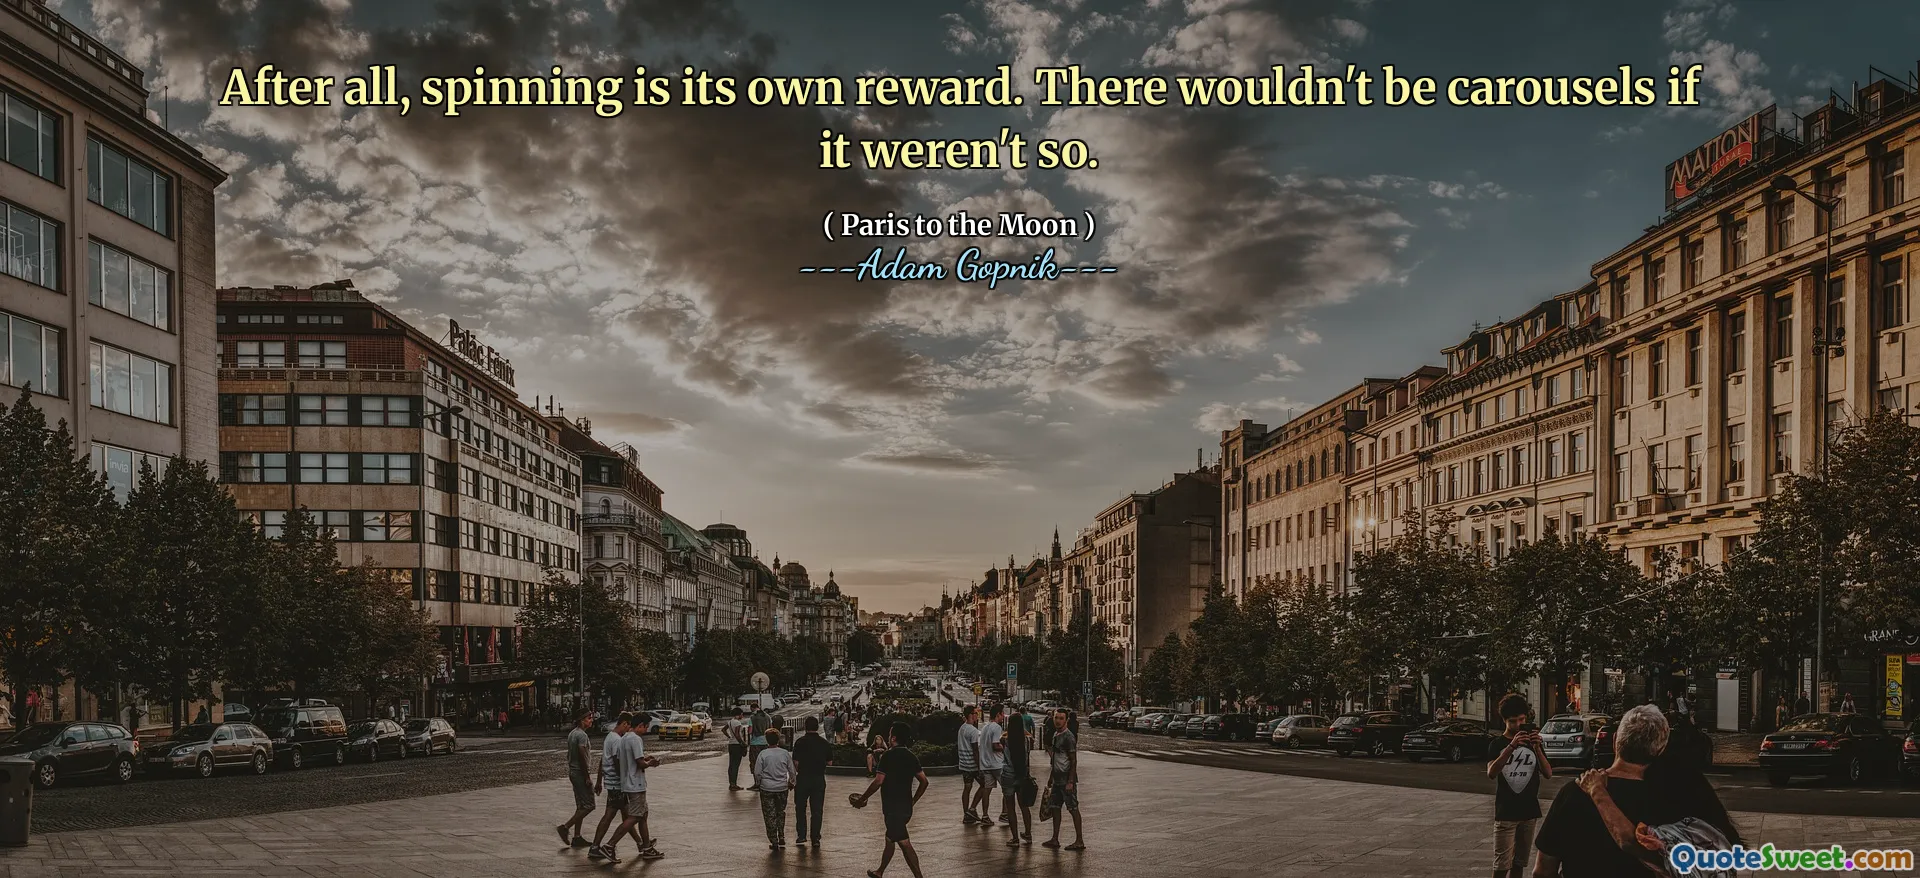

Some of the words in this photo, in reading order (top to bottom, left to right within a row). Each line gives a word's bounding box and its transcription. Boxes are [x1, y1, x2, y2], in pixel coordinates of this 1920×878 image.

[1669, 114, 1758, 190] MATTONI
[449, 318, 484, 367] Palác
[109, 458, 129, 473] invia
[1008, 665, 1015, 675] P
